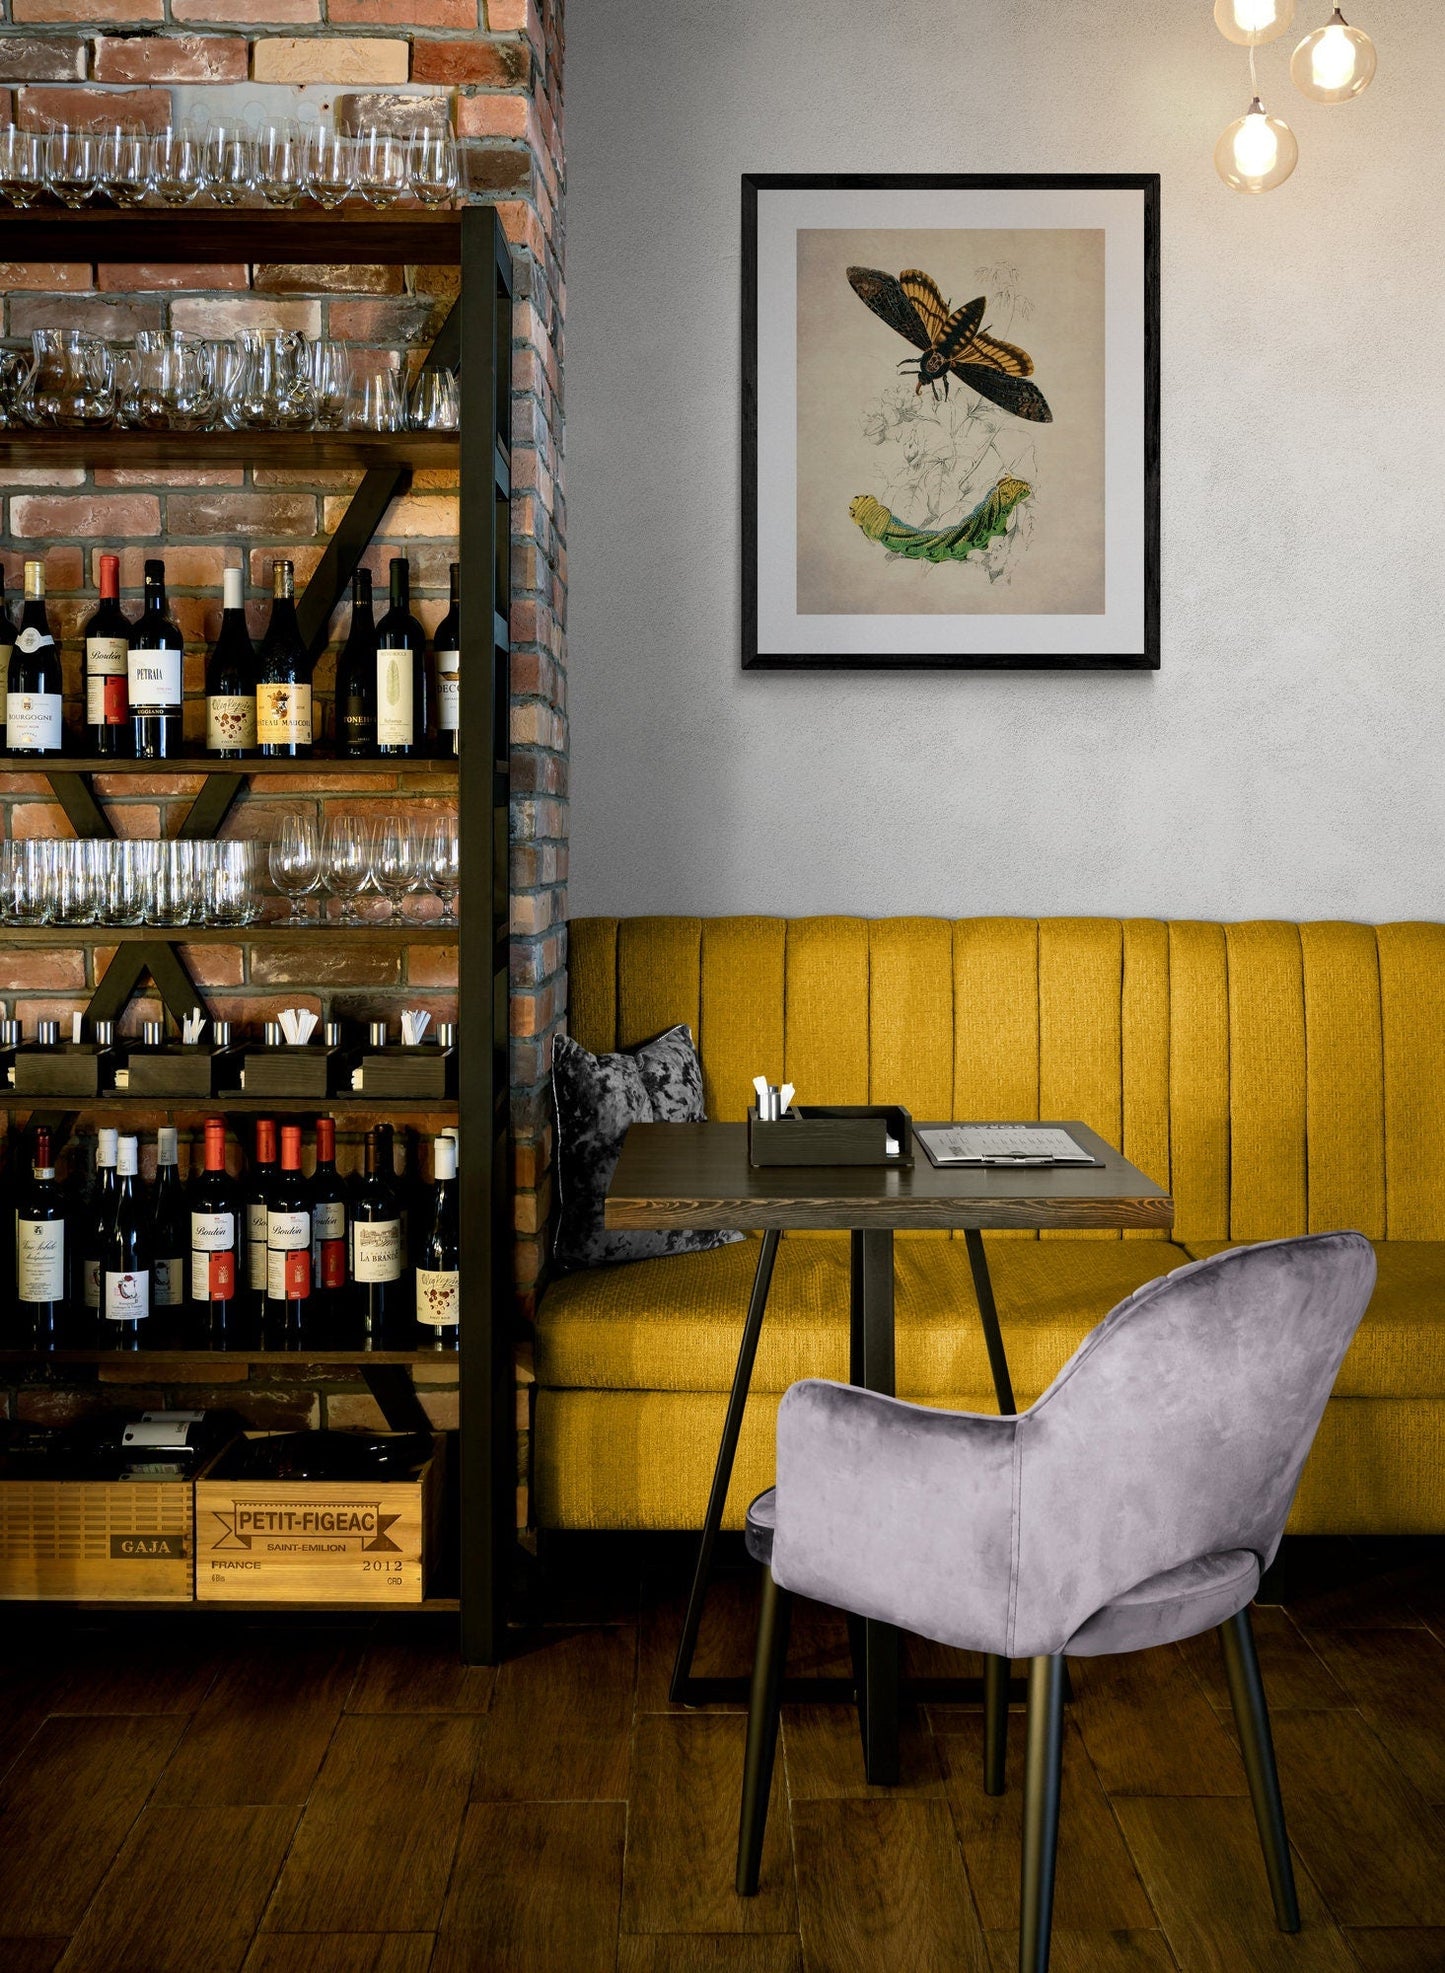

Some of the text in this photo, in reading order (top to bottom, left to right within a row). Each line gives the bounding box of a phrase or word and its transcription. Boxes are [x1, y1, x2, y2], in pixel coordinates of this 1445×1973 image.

[8, 713, 52, 721] BOURGOGNE
[252, 1216, 267, 1227] Bo
[360, 1247, 371, 1262] LA
[239, 1511, 375, 1532] PETIT-FIGEAC
[121, 1540, 172, 1553] GAJA
[266, 1543, 347, 1552] SAINT-EMILION
[211, 1560, 262, 1570] FRANCE
[362, 1560, 403, 1571] 2012
